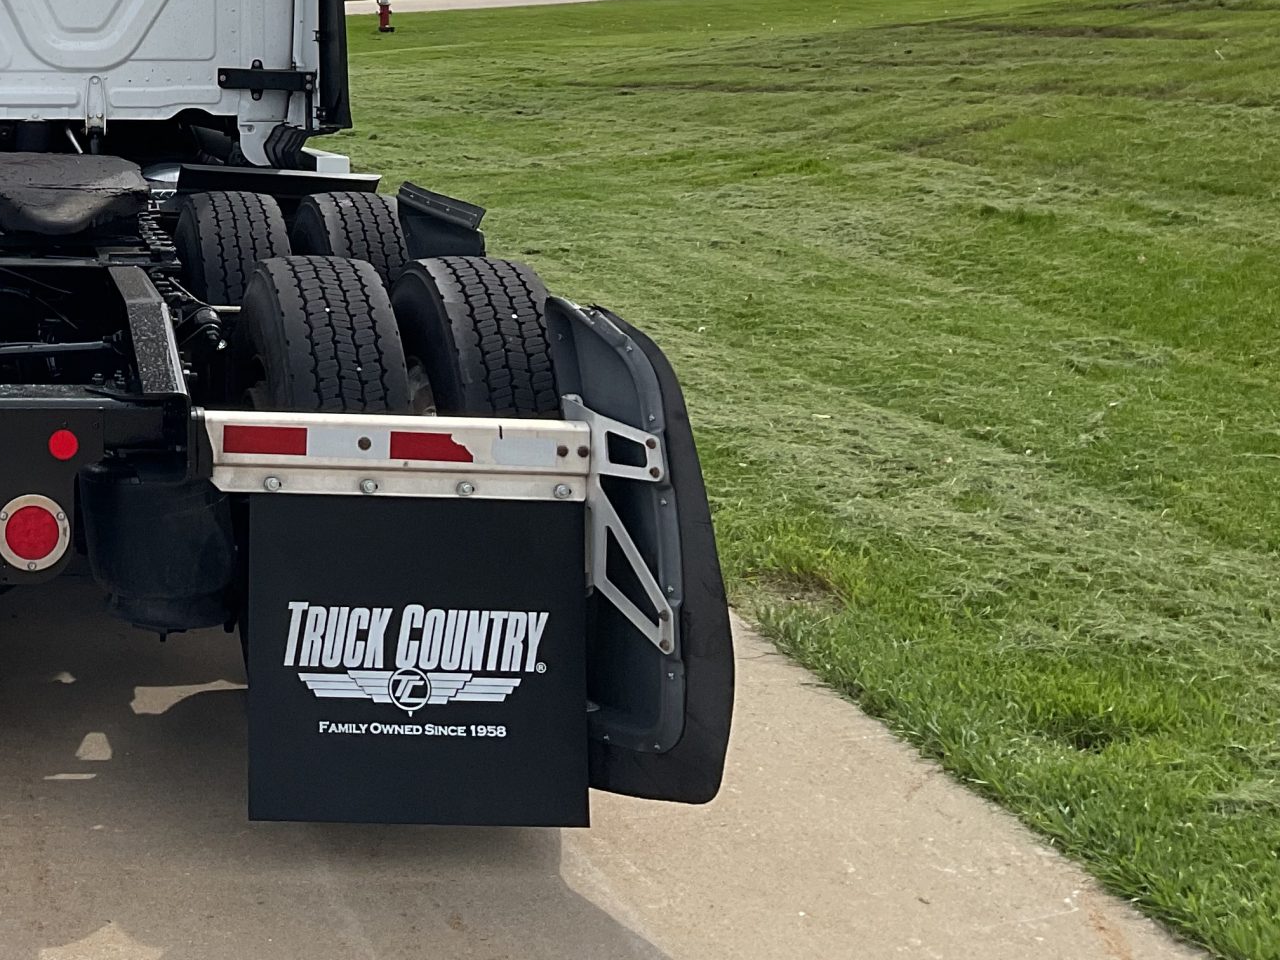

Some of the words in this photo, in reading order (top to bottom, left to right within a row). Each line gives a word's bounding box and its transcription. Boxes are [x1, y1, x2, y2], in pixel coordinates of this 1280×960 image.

[284, 602, 393, 668] TRUCK
[318, 721, 368, 735] FAMILY
[370, 723, 423, 736] OWNED
[424, 724, 467, 737] SINCE
[469, 725, 507, 738] 1958
